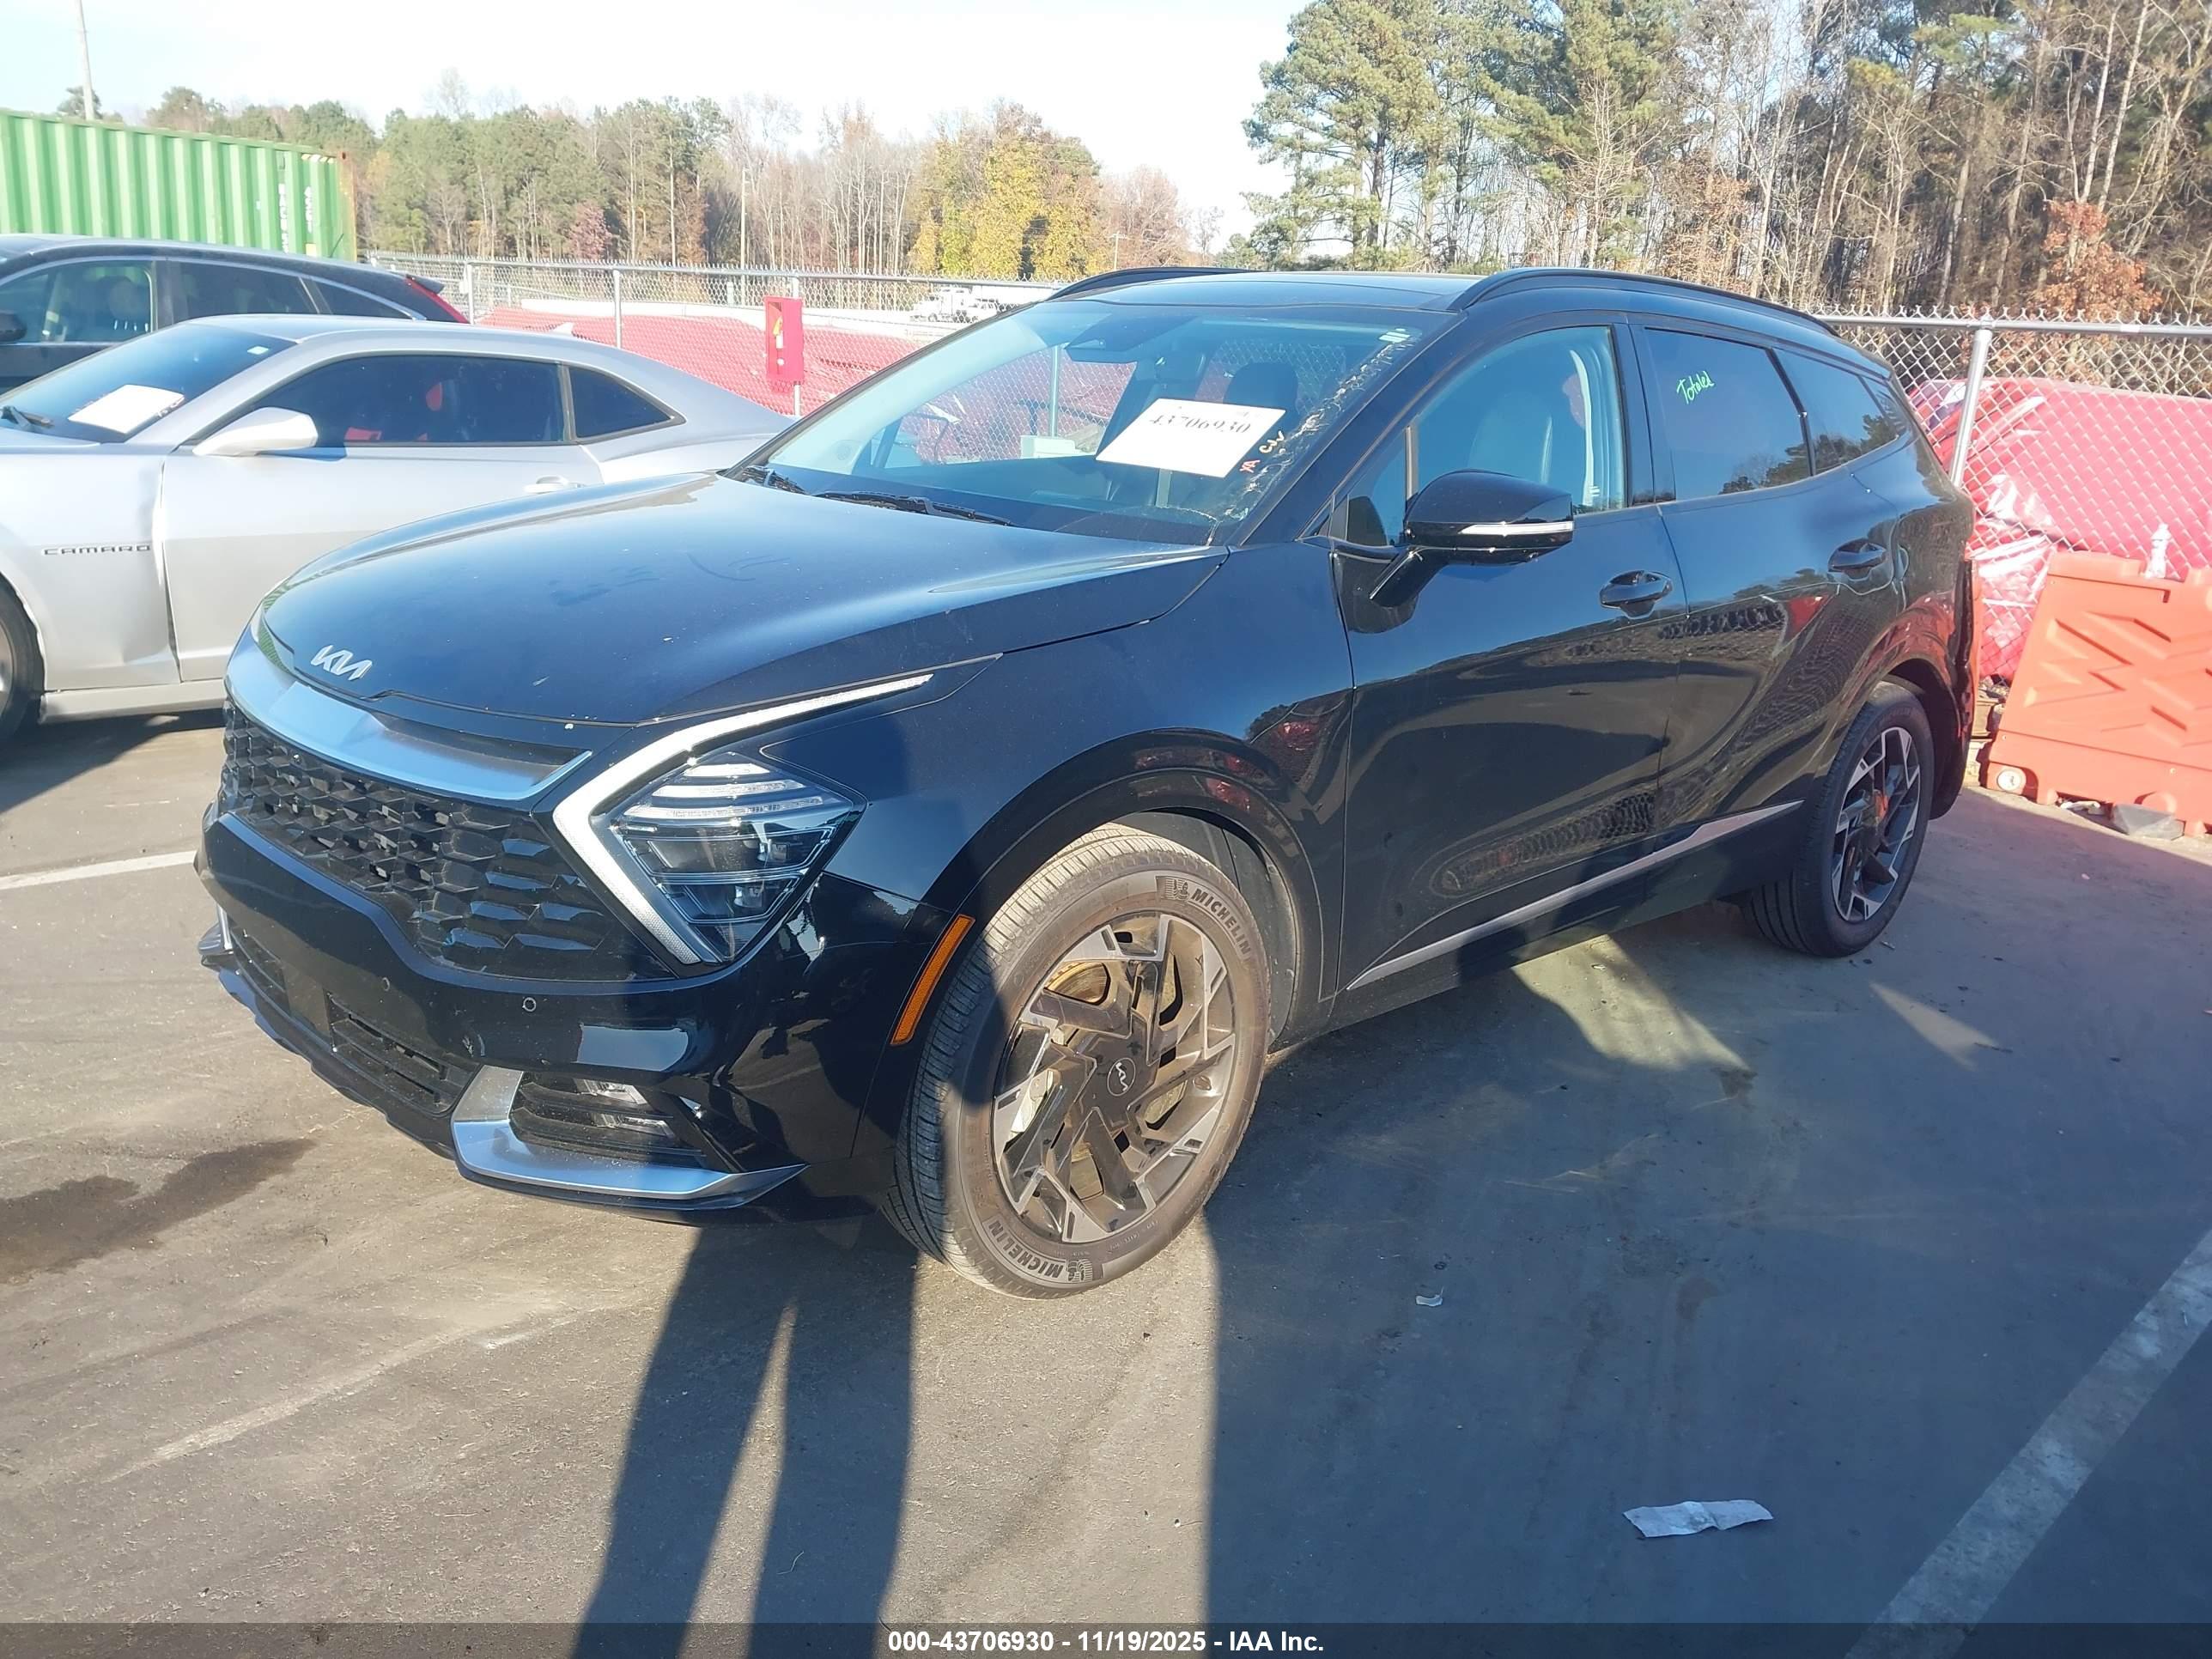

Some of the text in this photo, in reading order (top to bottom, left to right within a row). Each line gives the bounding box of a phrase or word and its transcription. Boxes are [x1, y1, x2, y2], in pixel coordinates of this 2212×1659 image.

[1149, 414, 1252, 434] 43706930
[43, 544, 150, 556] CAMARO
[1190, 888, 1251, 955] MICHELIN
[988, 1220, 1064, 1279] MICHELIN
